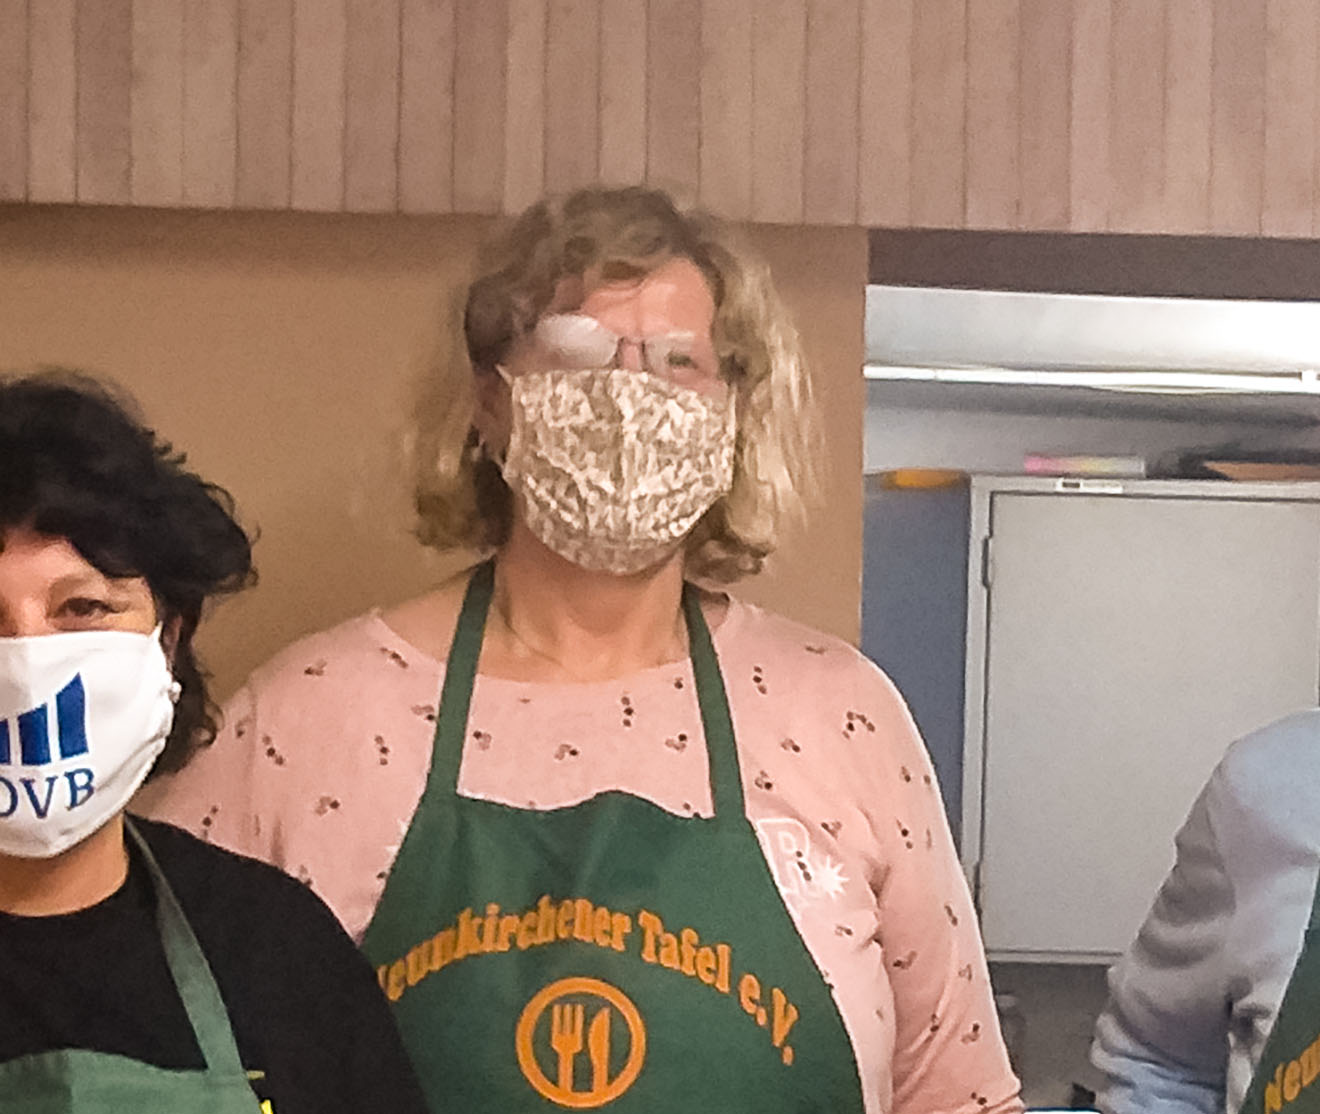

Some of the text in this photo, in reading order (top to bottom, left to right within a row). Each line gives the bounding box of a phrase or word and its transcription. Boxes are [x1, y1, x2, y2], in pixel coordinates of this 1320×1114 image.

[377, 895, 799, 1066] eunkirchener Tafel e.V.
